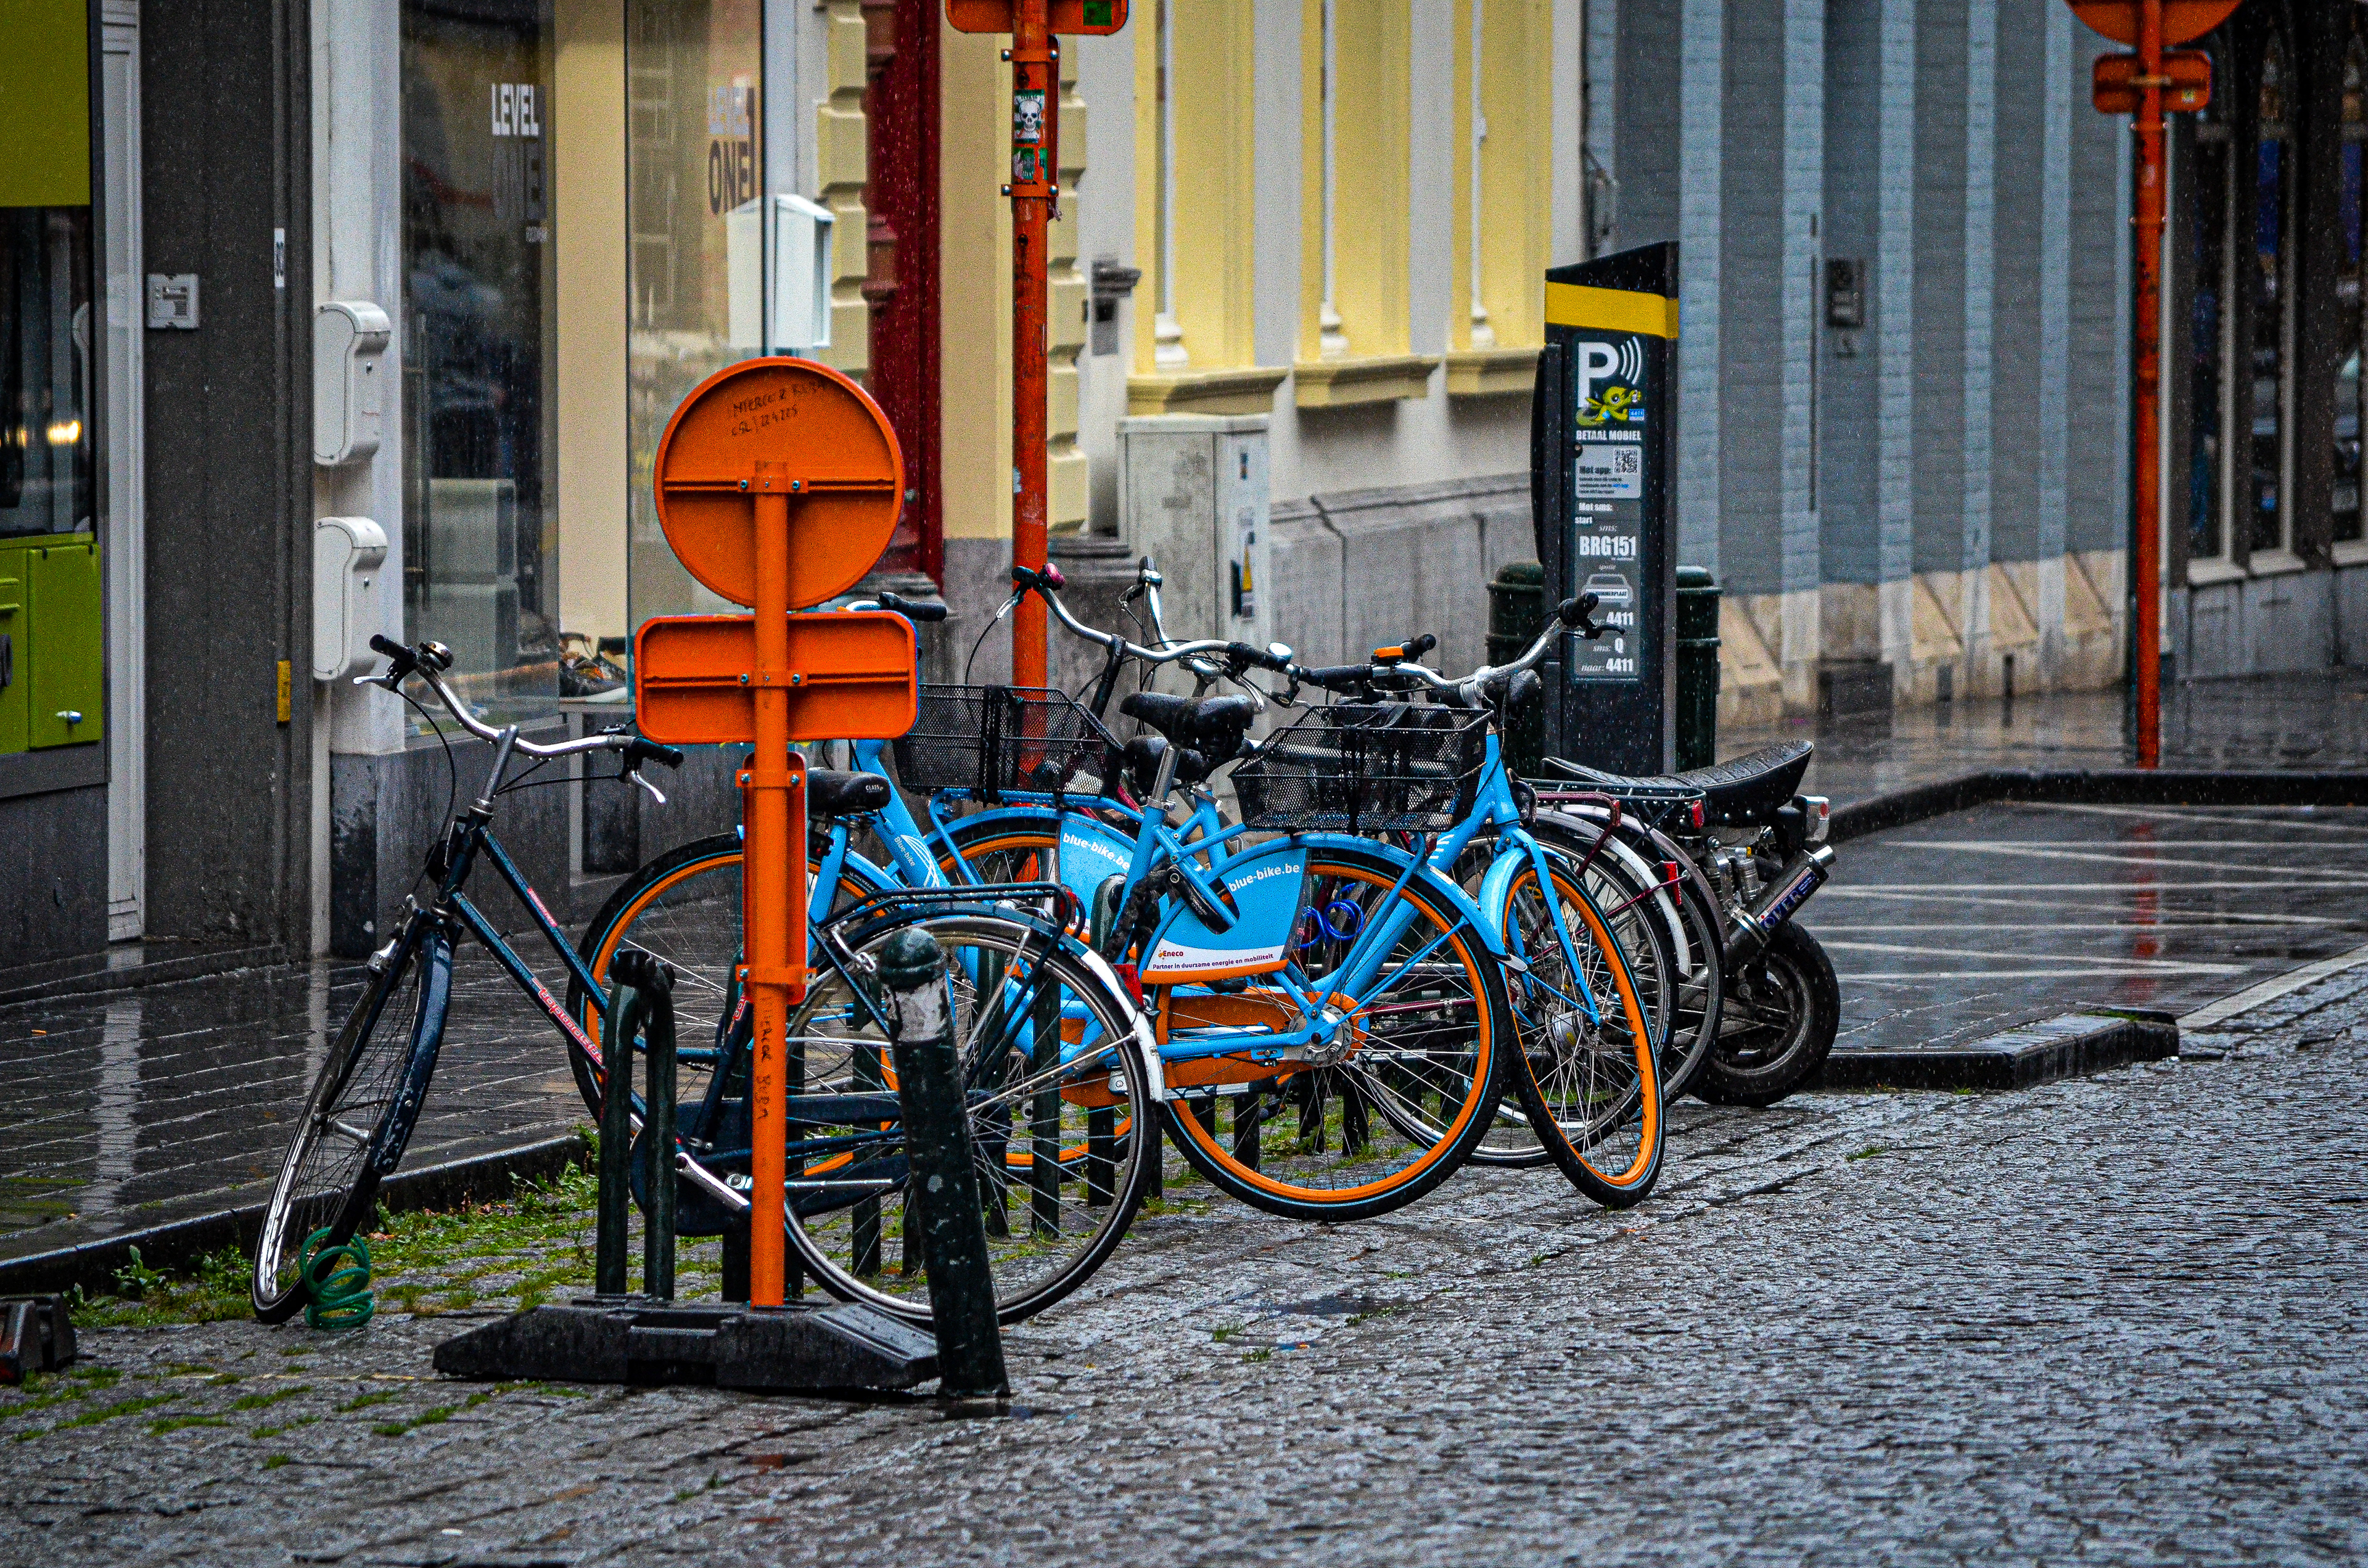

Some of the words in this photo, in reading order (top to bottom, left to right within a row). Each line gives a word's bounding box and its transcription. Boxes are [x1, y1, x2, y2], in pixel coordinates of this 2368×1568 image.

[492, 83, 539, 136] LEVEL
[709, 140, 750, 215] ONE
[1578, 342, 1619, 408] P
[1576, 430, 1607, 440] BETAAL
[1609, 430, 1641, 440] MOBIEL
[1579, 502, 1593, 511] Met
[1595, 503, 1613, 512] sms:
[1574, 516, 1593, 524] start
[1579, 535, 1637, 556] BRG151
[1606, 611, 1634, 626] 4411
[1614, 638, 1624, 654] Q
[1606, 657, 1634, 672] 4411
[894, 836, 916, 868] Blue-bike
[1063, 832, 1130, 870] blue-bike.be
[1228, 863, 1300, 892] blue-bike.be
[1212, 959, 1235, 967] energie
[1244, 953, 1274, 964] mobiliteit
